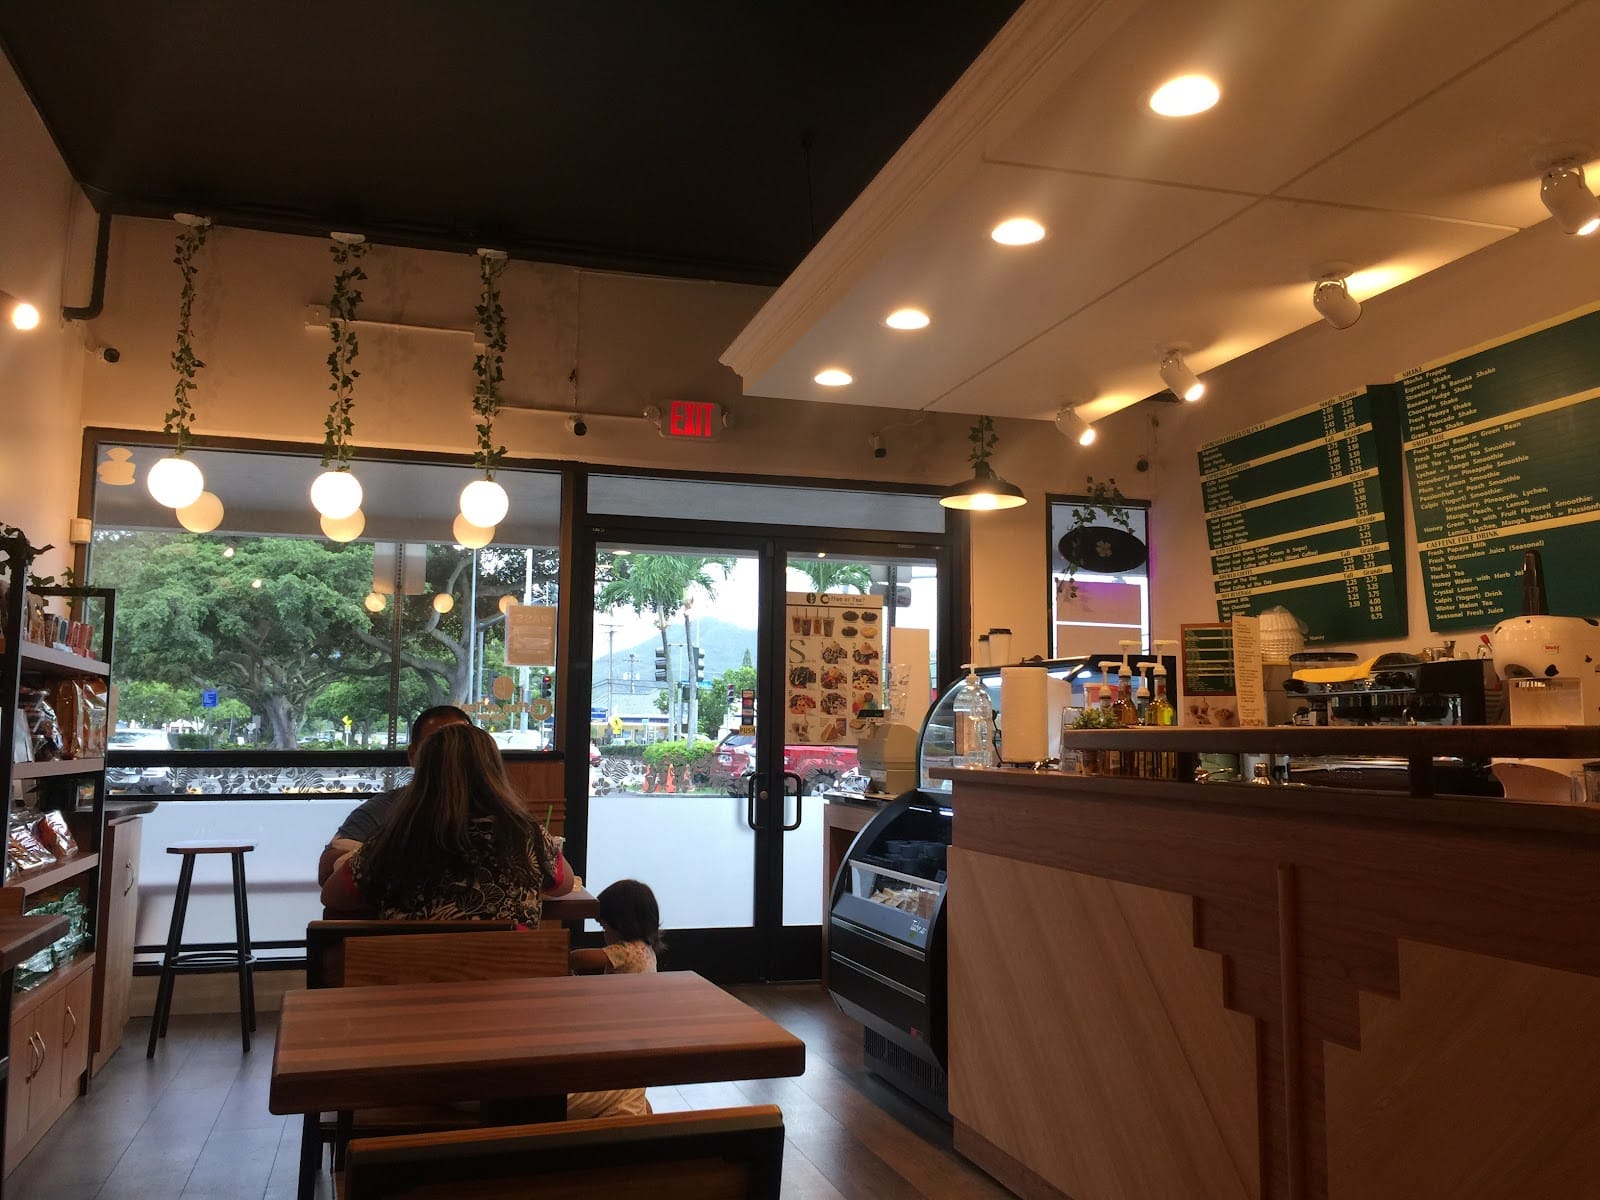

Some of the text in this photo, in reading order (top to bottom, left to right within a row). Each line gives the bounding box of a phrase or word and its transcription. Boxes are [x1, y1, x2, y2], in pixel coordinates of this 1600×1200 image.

[1405, 374, 1451, 394] Espresso Shake
[1406, 388, 1438, 400] Strawberry
[1450, 376, 1472, 386] Banana
[1476, 368, 1496, 378] Shake
[1407, 384, 1472, 408] Banana Fudge Shake
[1408, 397, 1458, 416] Chocolate Shake
[1409, 401, 1472, 424] Fresh Papaya Shake
[671, 400, 715, 438] EXIT
[1410, 408, 1478, 432] Fresh Avocado Shake
[1411, 432, 1428, 440] Green
[1413, 447, 1429, 456] Fresh
[1481, 428, 1500, 437] Green
[1414, 454, 1430, 463] Fresh
[1450, 442, 1480, 453] Smoothie
[1484, 440, 1516, 453] Smoothie
[1416, 452, 1504, 479] Lychee Mango Smoothie
[1418, 455, 1529, 486] Strawberry Pineapple Smoothie
[1419, 474, 1520, 502] Passionfruit Peach Smoothie
[1445, 479, 1466, 488] Lemon
[1470, 471, 1500, 482] Smoothie
[1442, 495, 1466, 506] (Yogurt)
[1506, 500, 1530, 508] Lemon
[1424, 526, 1443, 534] Honey
[1501, 510, 1517, 518] Fruit
[1521, 502, 1551, 514] Flavored
[1426, 530, 1500, 548] CAFFEINE FREE DRINK
[1428, 541, 1486, 557] Fresh Papaya Milk
[1428, 540, 1544, 564] Fresh Watermelon Juice (Seasonal)
[1431, 572, 1450, 580] Herbal
[1494, 571, 1510, 579] Herb
[1433, 585, 1478, 597] Crystal Lemon
[1434, 589, 1503, 604] Calpis (Yogurt) Drink
[1435, 604, 1456, 612] Winter
[1436, 611, 1464, 620] Seasonal
[1466, 608, 1484, 616] Fresh
